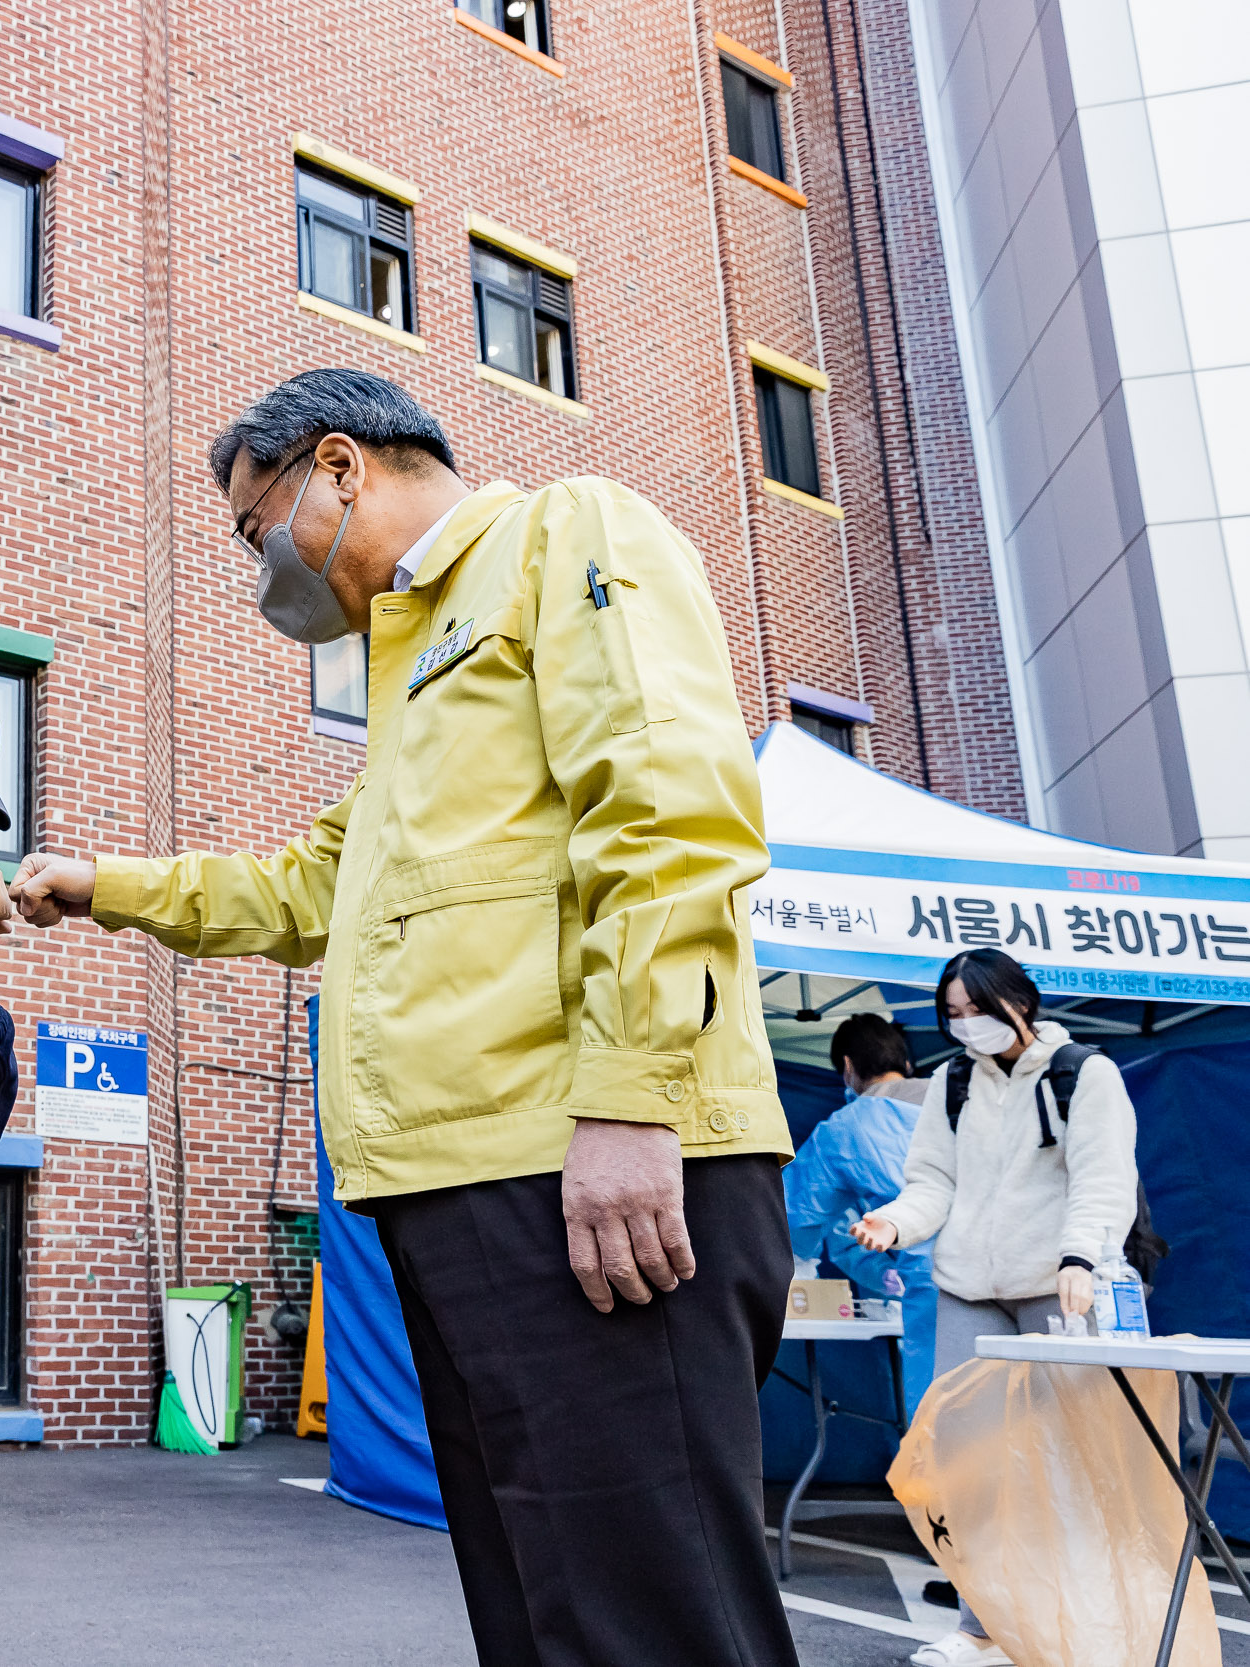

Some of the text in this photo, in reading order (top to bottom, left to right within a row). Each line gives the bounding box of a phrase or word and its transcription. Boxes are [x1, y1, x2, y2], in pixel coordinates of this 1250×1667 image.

[1067, 870, 1140, 891] 코로나19
[751, 898, 878, 934] 서울특별시
[908, 895, 1250, 962] 서울시 찾아가는
[1029, 968, 1079, 987] 로나19
[1082, 972, 1149, 994] 대응지원반
[48, 1023, 138, 1046] 장애인전용 주차구역
[66, 1042, 95, 1088] P
